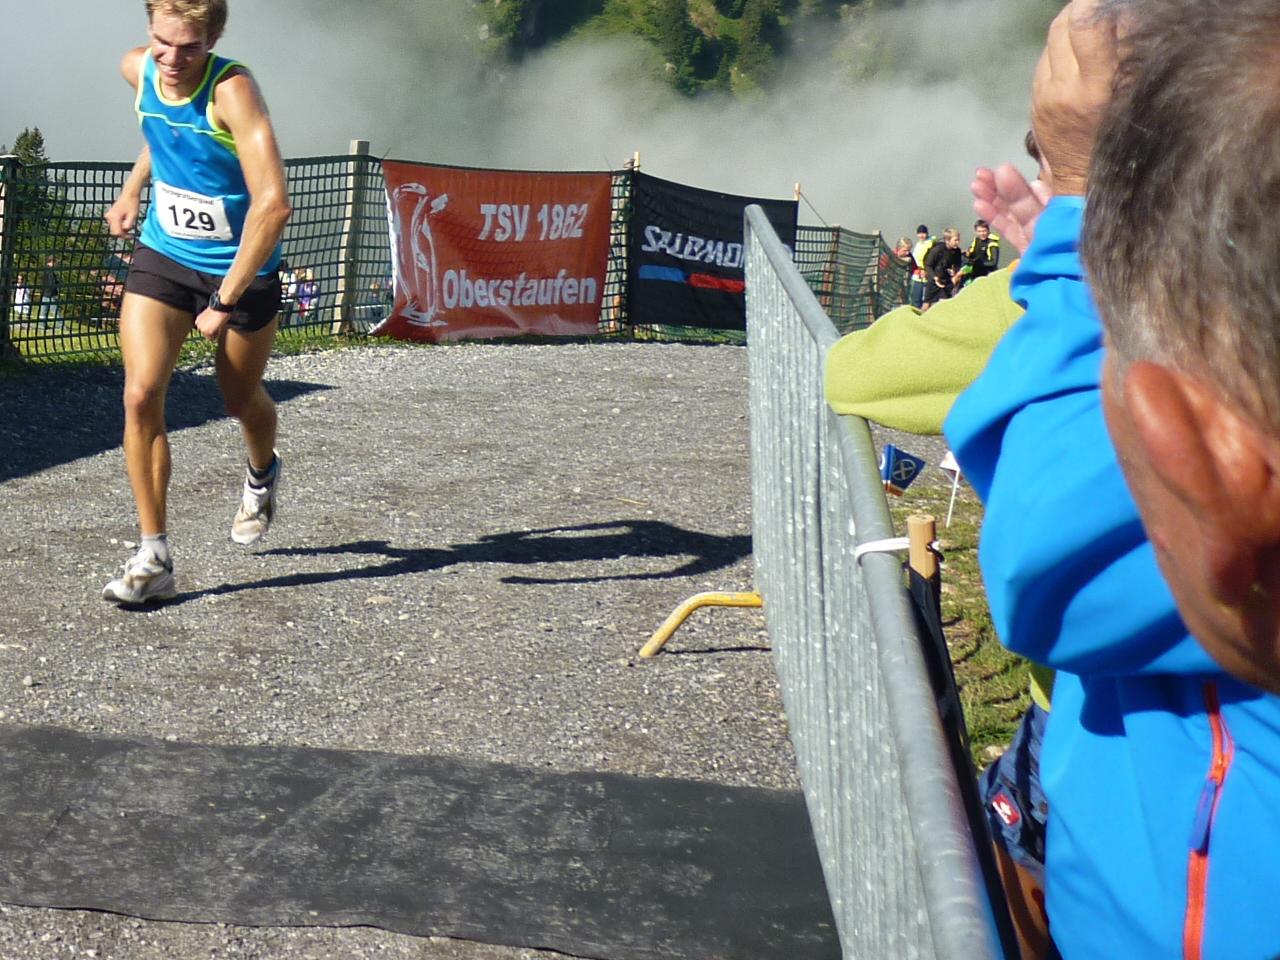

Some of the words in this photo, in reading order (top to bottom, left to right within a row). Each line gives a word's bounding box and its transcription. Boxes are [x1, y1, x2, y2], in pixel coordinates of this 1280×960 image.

[168, 204, 216, 232] 129
[477, 203, 531, 242] TSV
[537, 203, 589, 240] 1862
[441, 268, 597, 309] Oberstaufen
